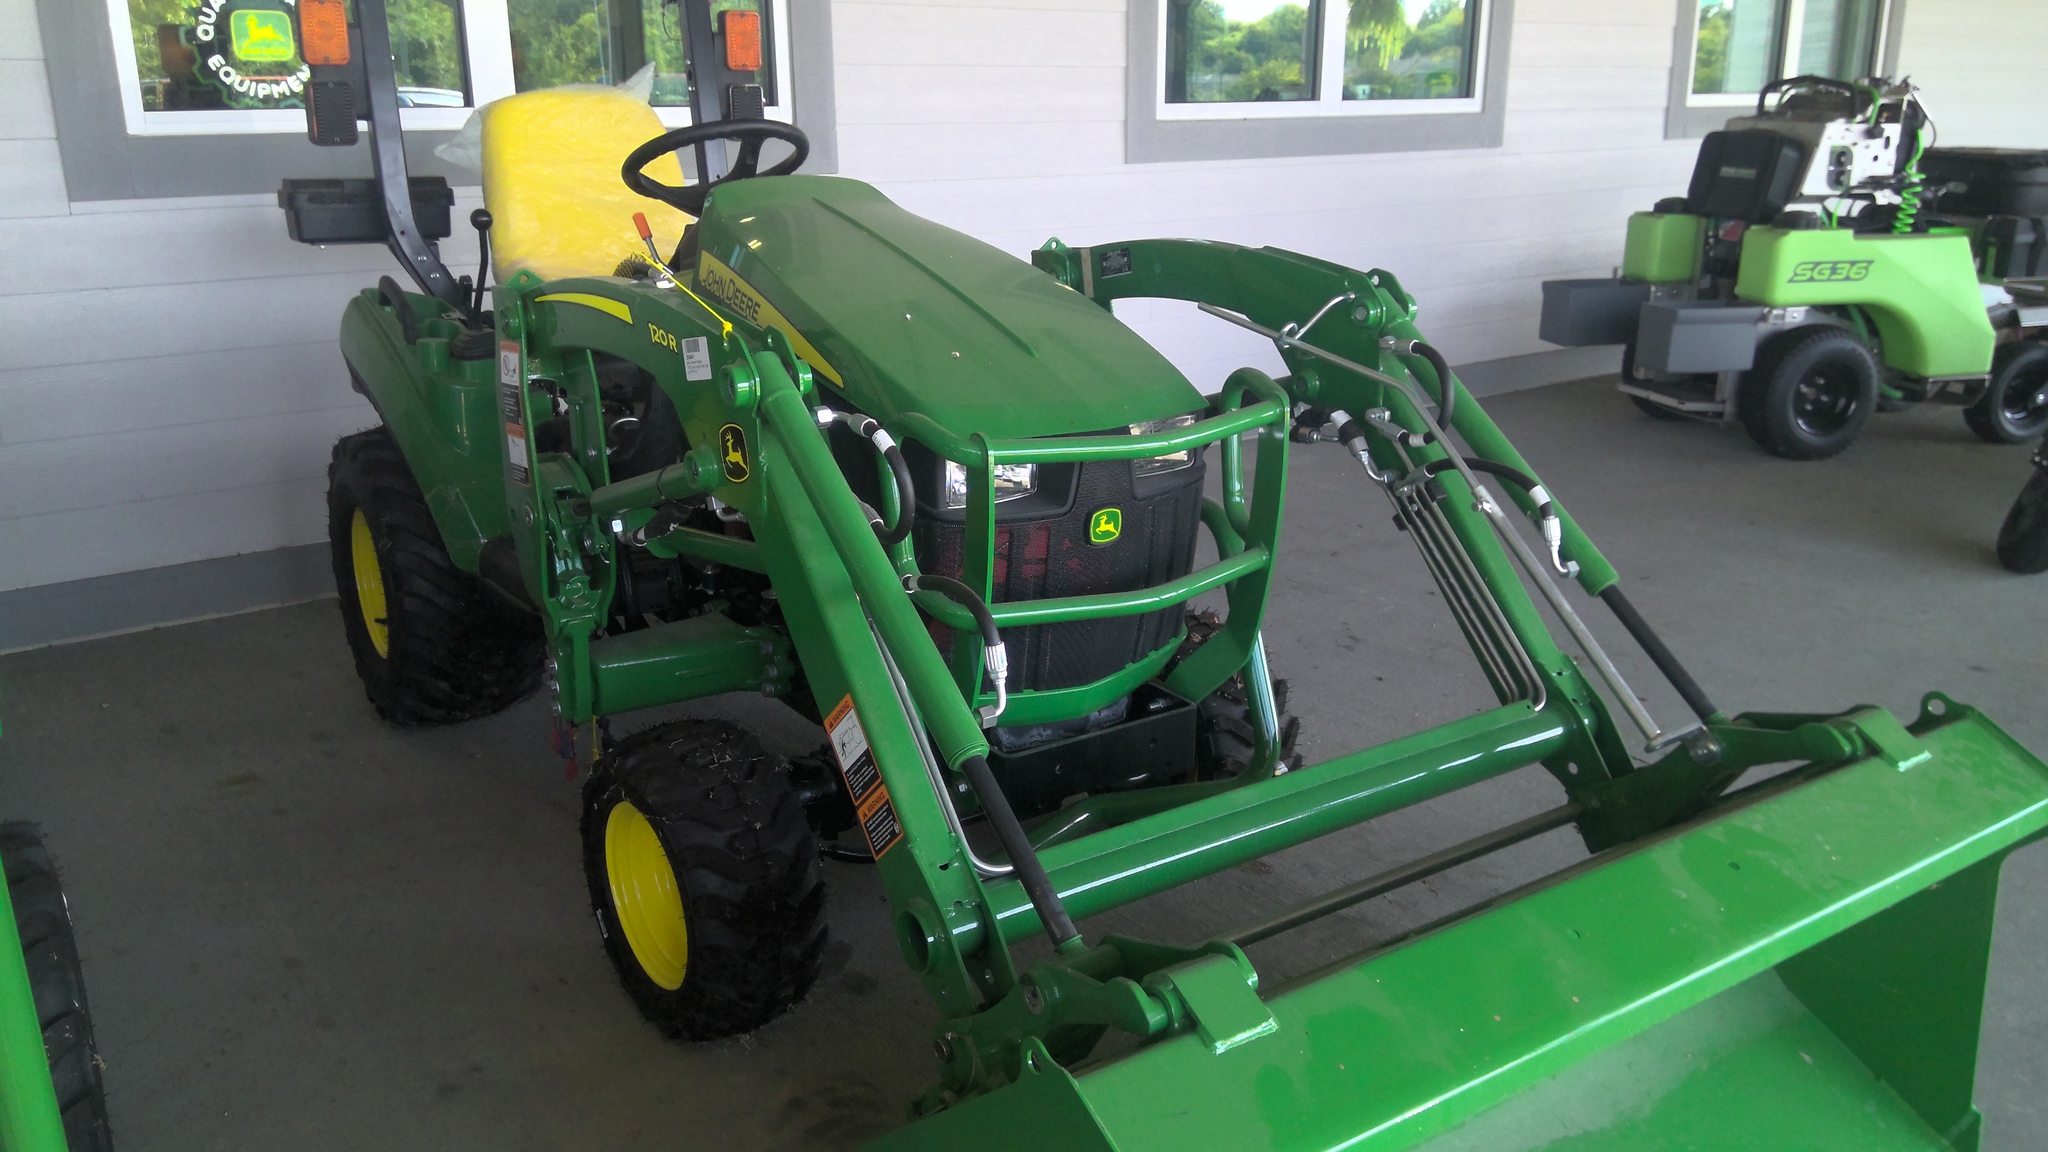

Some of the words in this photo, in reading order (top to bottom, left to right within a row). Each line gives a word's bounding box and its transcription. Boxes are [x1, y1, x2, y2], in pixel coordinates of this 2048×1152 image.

[207, 54, 311, 98] EQUIPMEN
[1792, 262, 1869, 281] SG36
[701, 264, 727, 300] JOHN
[724, 278, 761, 322] DEERE
[832, 700, 850, 723] WARNING
[867, 791, 885, 813] WARNING
